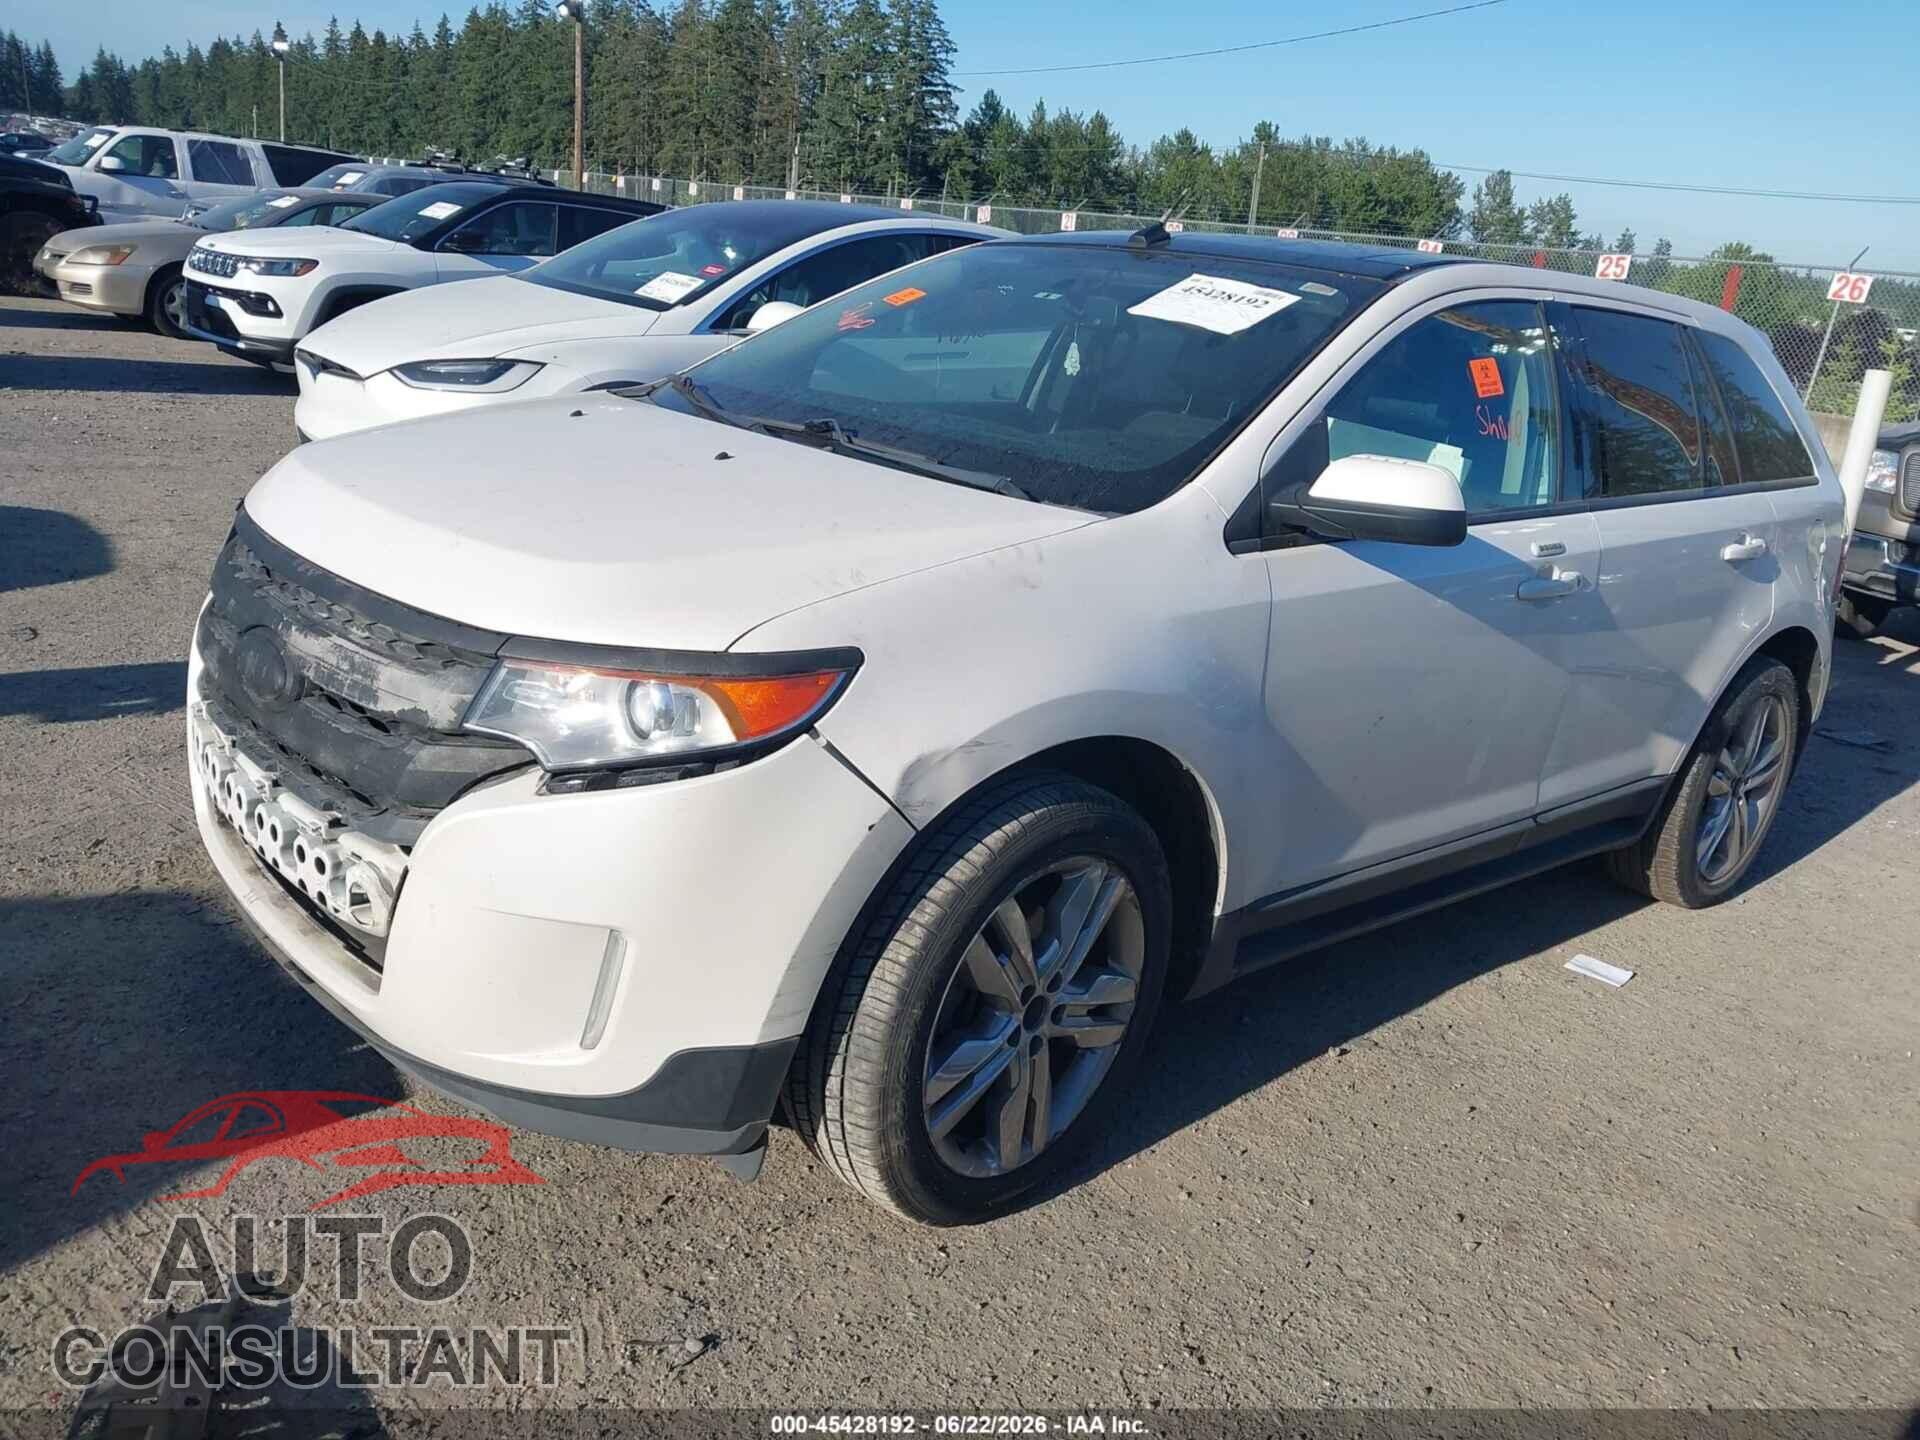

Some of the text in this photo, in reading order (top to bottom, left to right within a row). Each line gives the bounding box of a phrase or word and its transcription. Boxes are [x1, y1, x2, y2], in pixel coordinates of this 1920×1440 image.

[1599, 255, 1627, 278] 25
[1181, 285, 1271, 309] 45428192
[1831, 275, 1866, 300] 26
